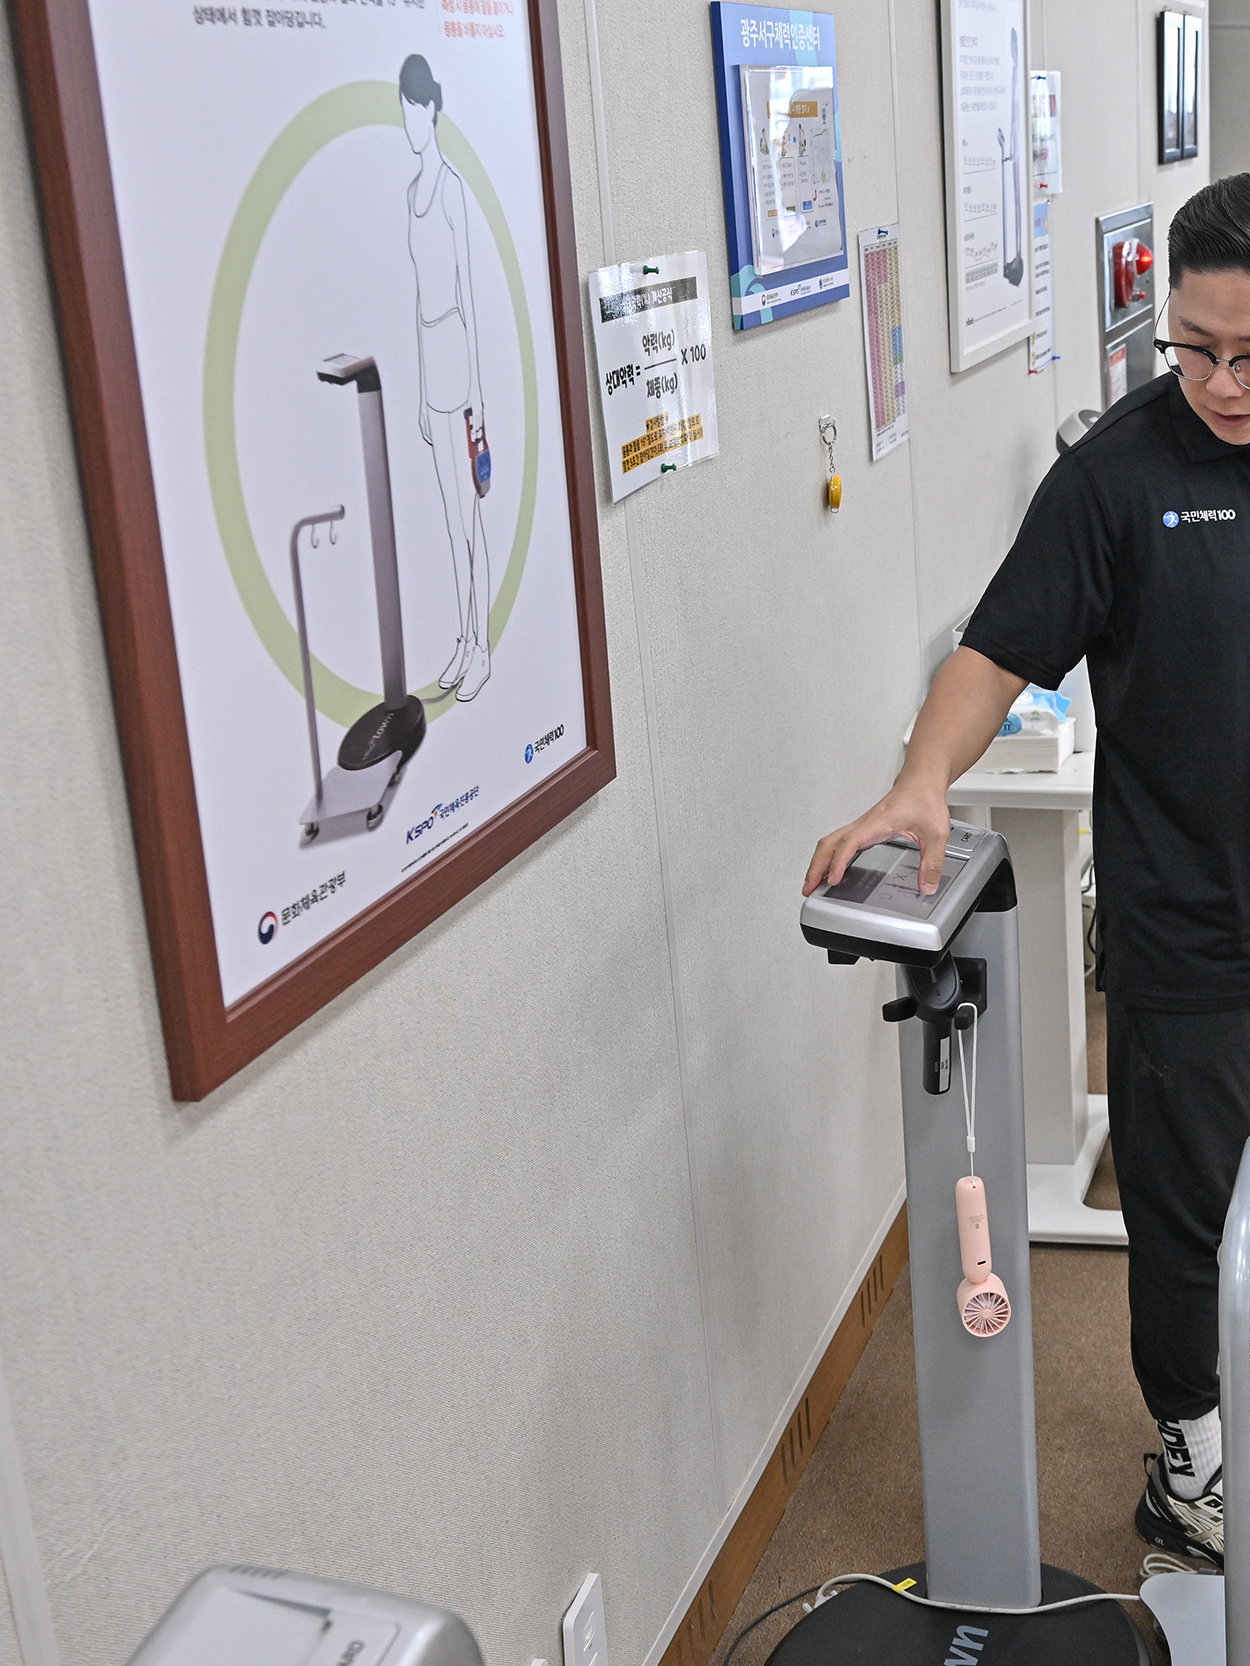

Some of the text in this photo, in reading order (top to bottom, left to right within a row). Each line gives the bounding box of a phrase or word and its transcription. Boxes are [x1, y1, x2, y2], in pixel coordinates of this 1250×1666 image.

[192, 5, 238, 26] 상태에서
[740, 18, 821, 52] 광주서구체력인증센터
[651, 286, 673, 304] 계산공식
[642, 329, 675, 357] 악력(kg)
[690, 343, 707, 363] 100
[605, 363, 636, 396] 상대악력
[646, 372, 679, 399] 체중(kg)
[1180, 508, 1237, 524] 국민체력100
[534, 723, 565, 754] 국민체력100
[406, 816, 434, 845] KSPO
[280, 870, 347, 926] 문화체육관광부
